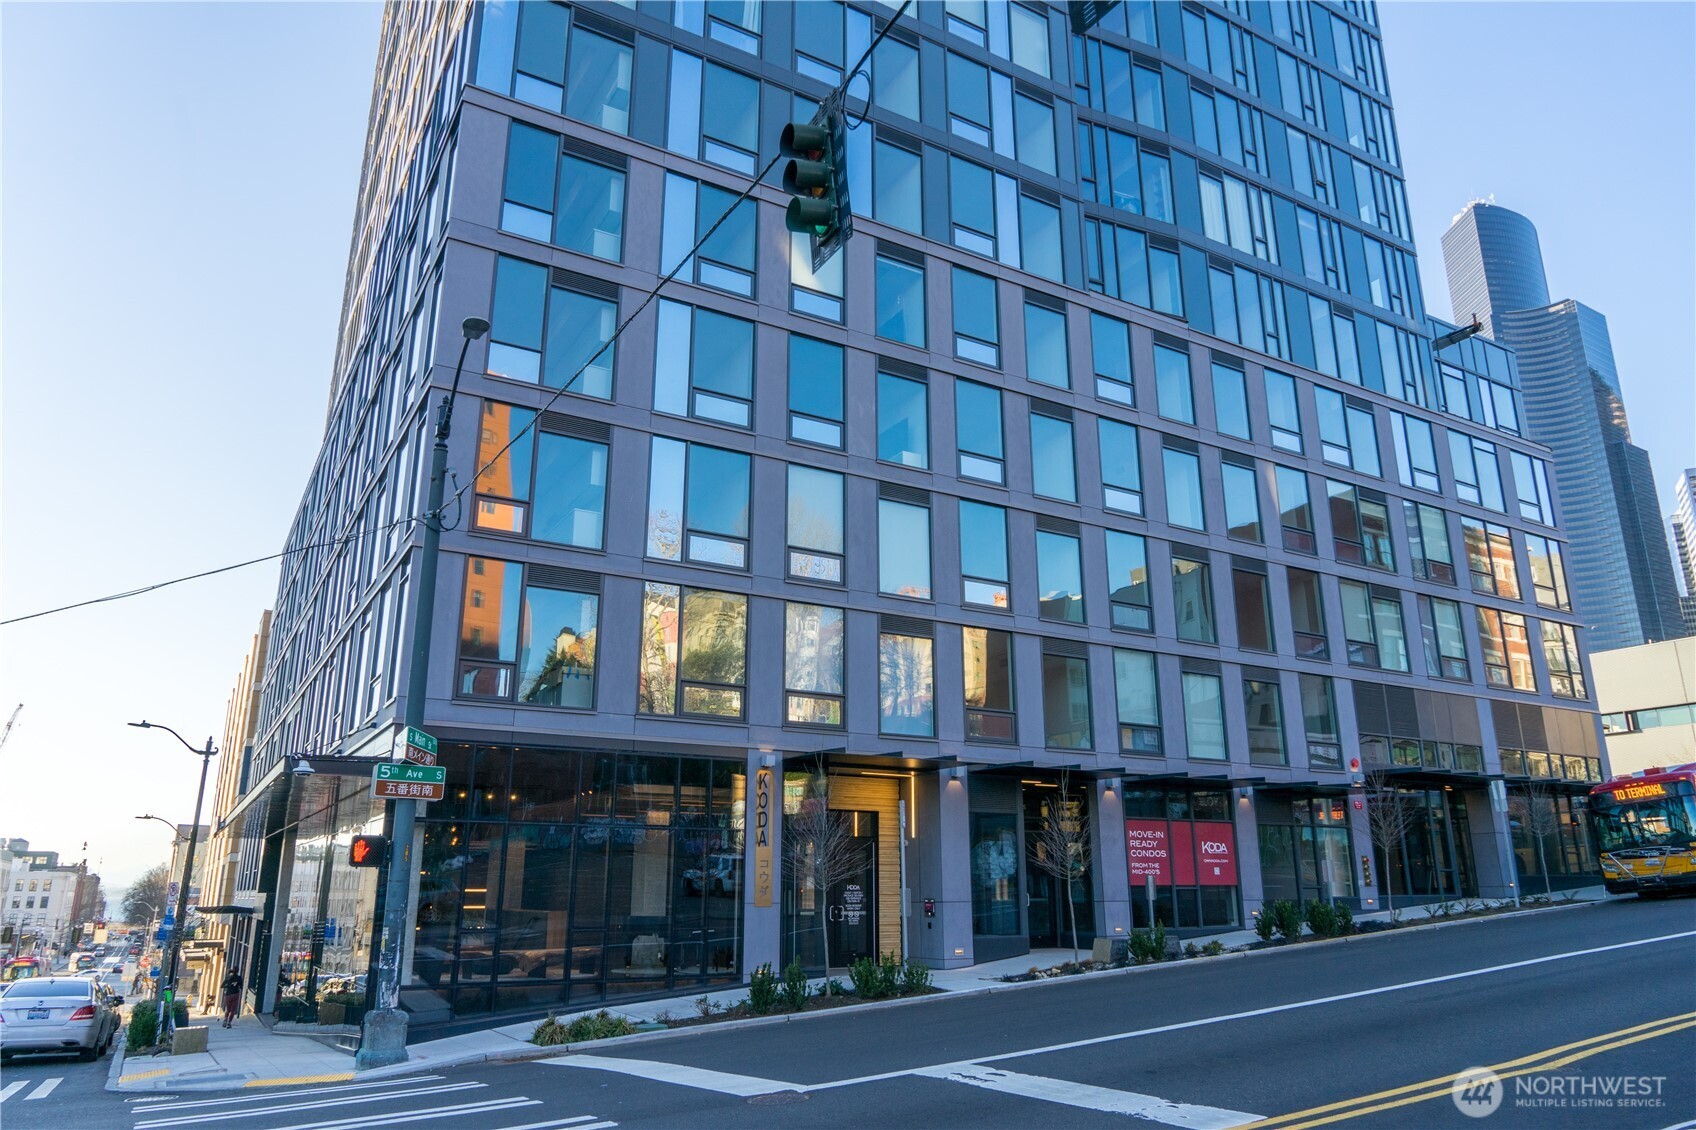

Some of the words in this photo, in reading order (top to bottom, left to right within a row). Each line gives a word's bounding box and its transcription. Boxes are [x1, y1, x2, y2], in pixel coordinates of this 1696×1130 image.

[409, 732, 413, 741] S
[414, 731, 426, 747] Main
[380, 765, 399, 778] 5th
[405, 769, 424, 779] Ave
[436, 772, 442, 780] S
[384, 782, 434, 796] 五番街南
[1613, 790, 1626, 801] TO
[1626, 784, 1666, 799] TERMINAL
[758, 772, 768, 847] KODA
[1129, 830, 1164, 838] MOVE-IN
[1130, 849, 1167, 858] CONDOS
[1201, 841, 1228, 854] KODA
